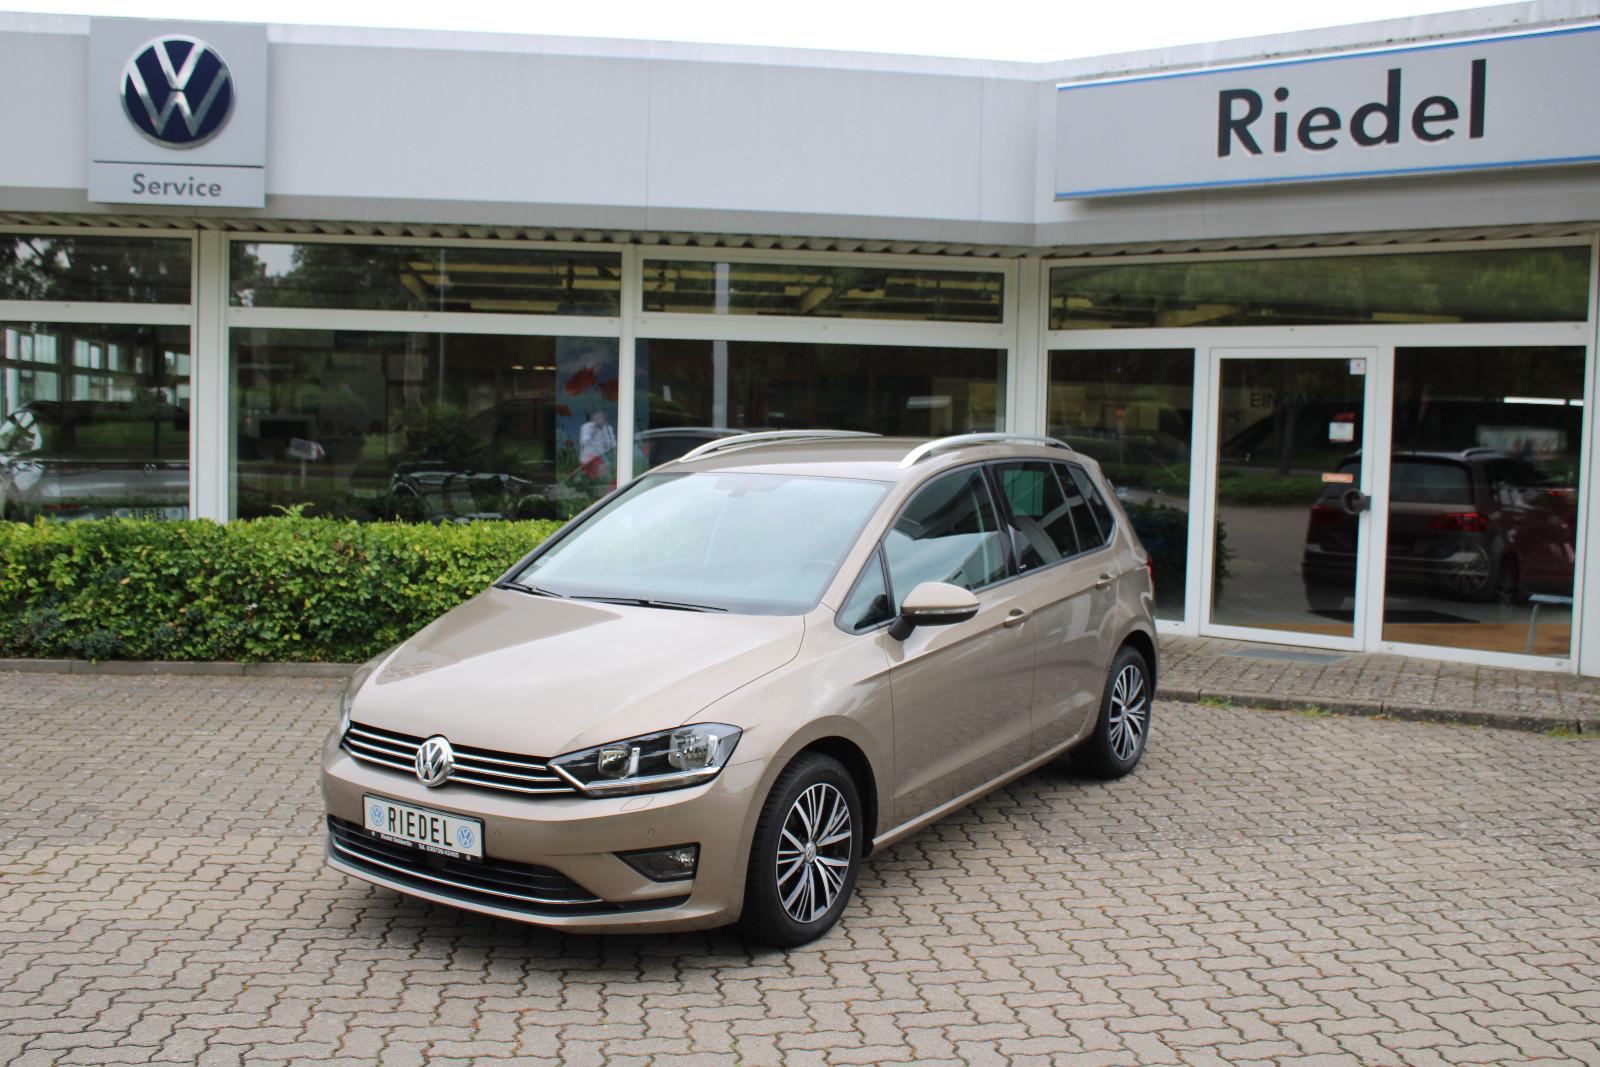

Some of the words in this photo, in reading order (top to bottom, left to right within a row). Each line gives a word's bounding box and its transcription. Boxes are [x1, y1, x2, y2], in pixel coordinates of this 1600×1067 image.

[121, 36, 235, 149] VW
[1217, 58, 1487, 158] Riedel
[132, 172, 222, 197] Service
[388, 806, 453, 847] RIEDEL
